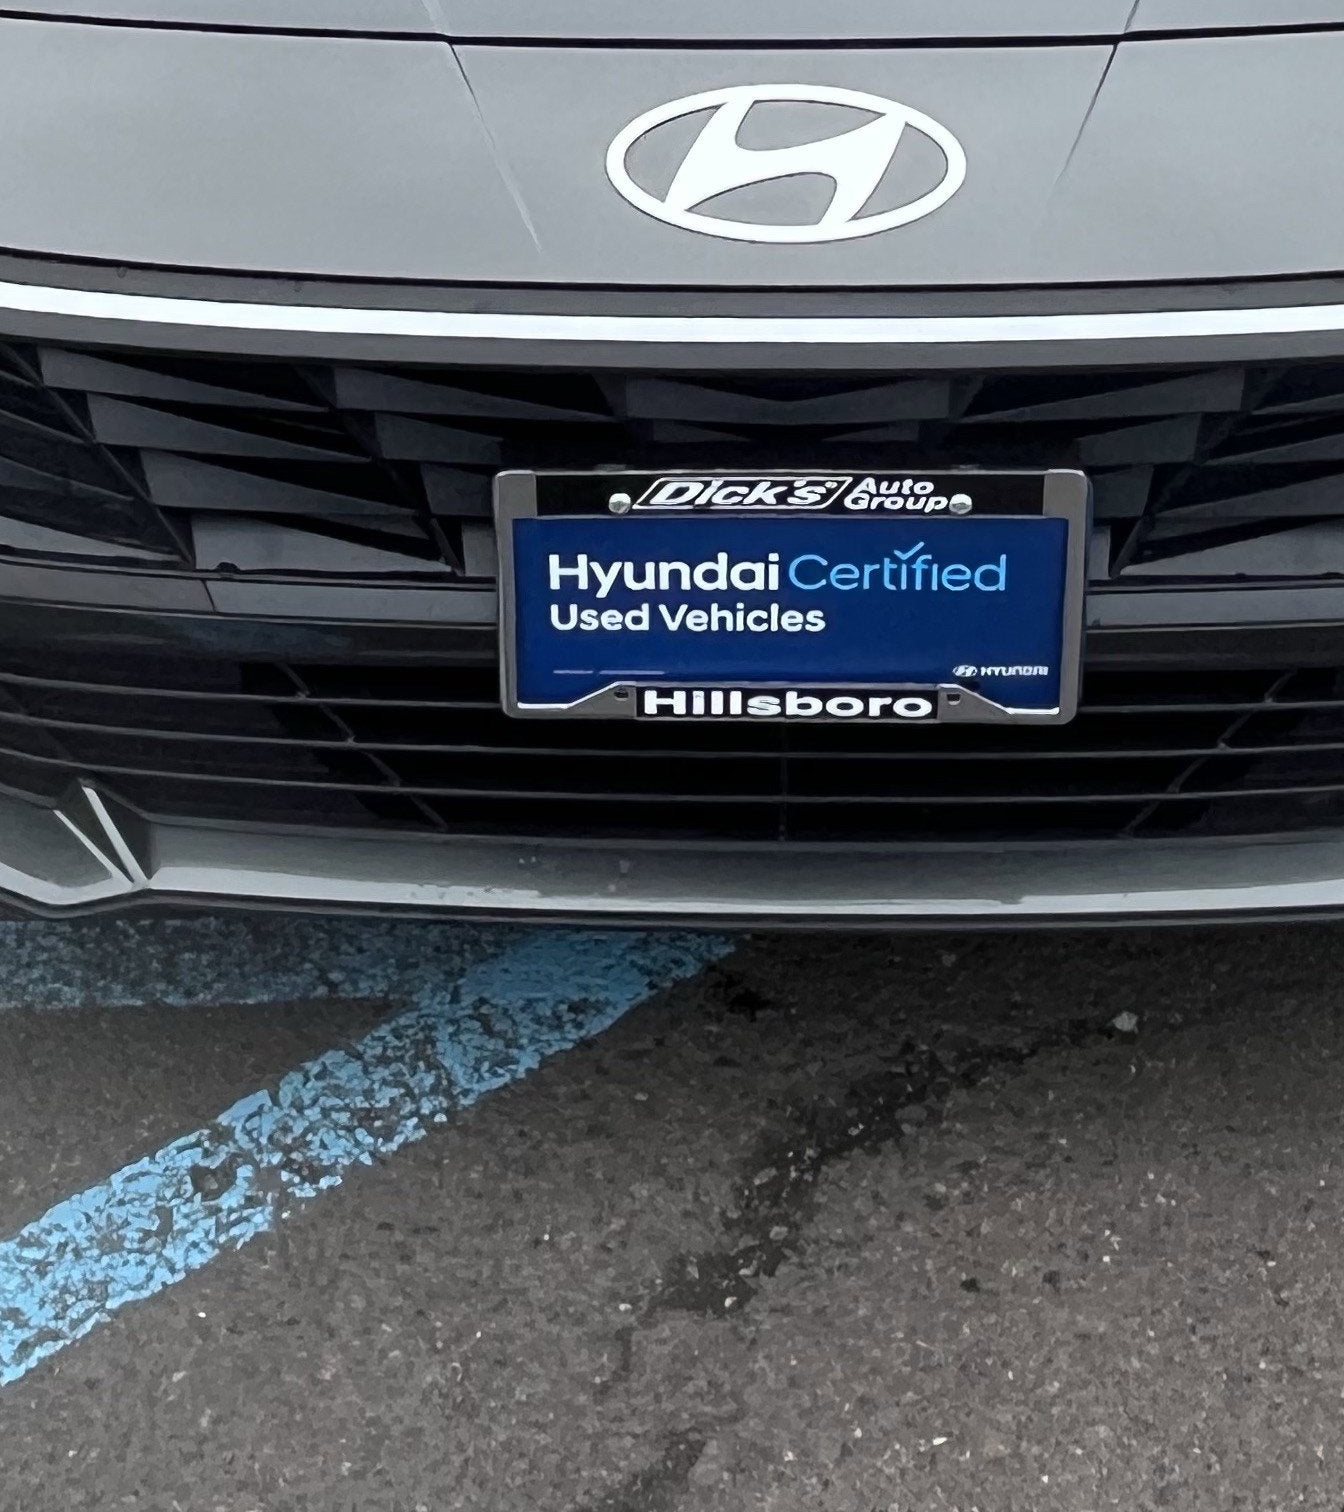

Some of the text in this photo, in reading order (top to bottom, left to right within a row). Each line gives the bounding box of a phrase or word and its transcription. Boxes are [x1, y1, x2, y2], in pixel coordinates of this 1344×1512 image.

[852, 476, 935, 495] Auto
[843, 492, 949, 514] Group
[549, 541, 1007, 598] Hyundai Certified
[550, 603, 826, 632] Used Vehicles
[643, 689, 934, 718] Hillsboro
